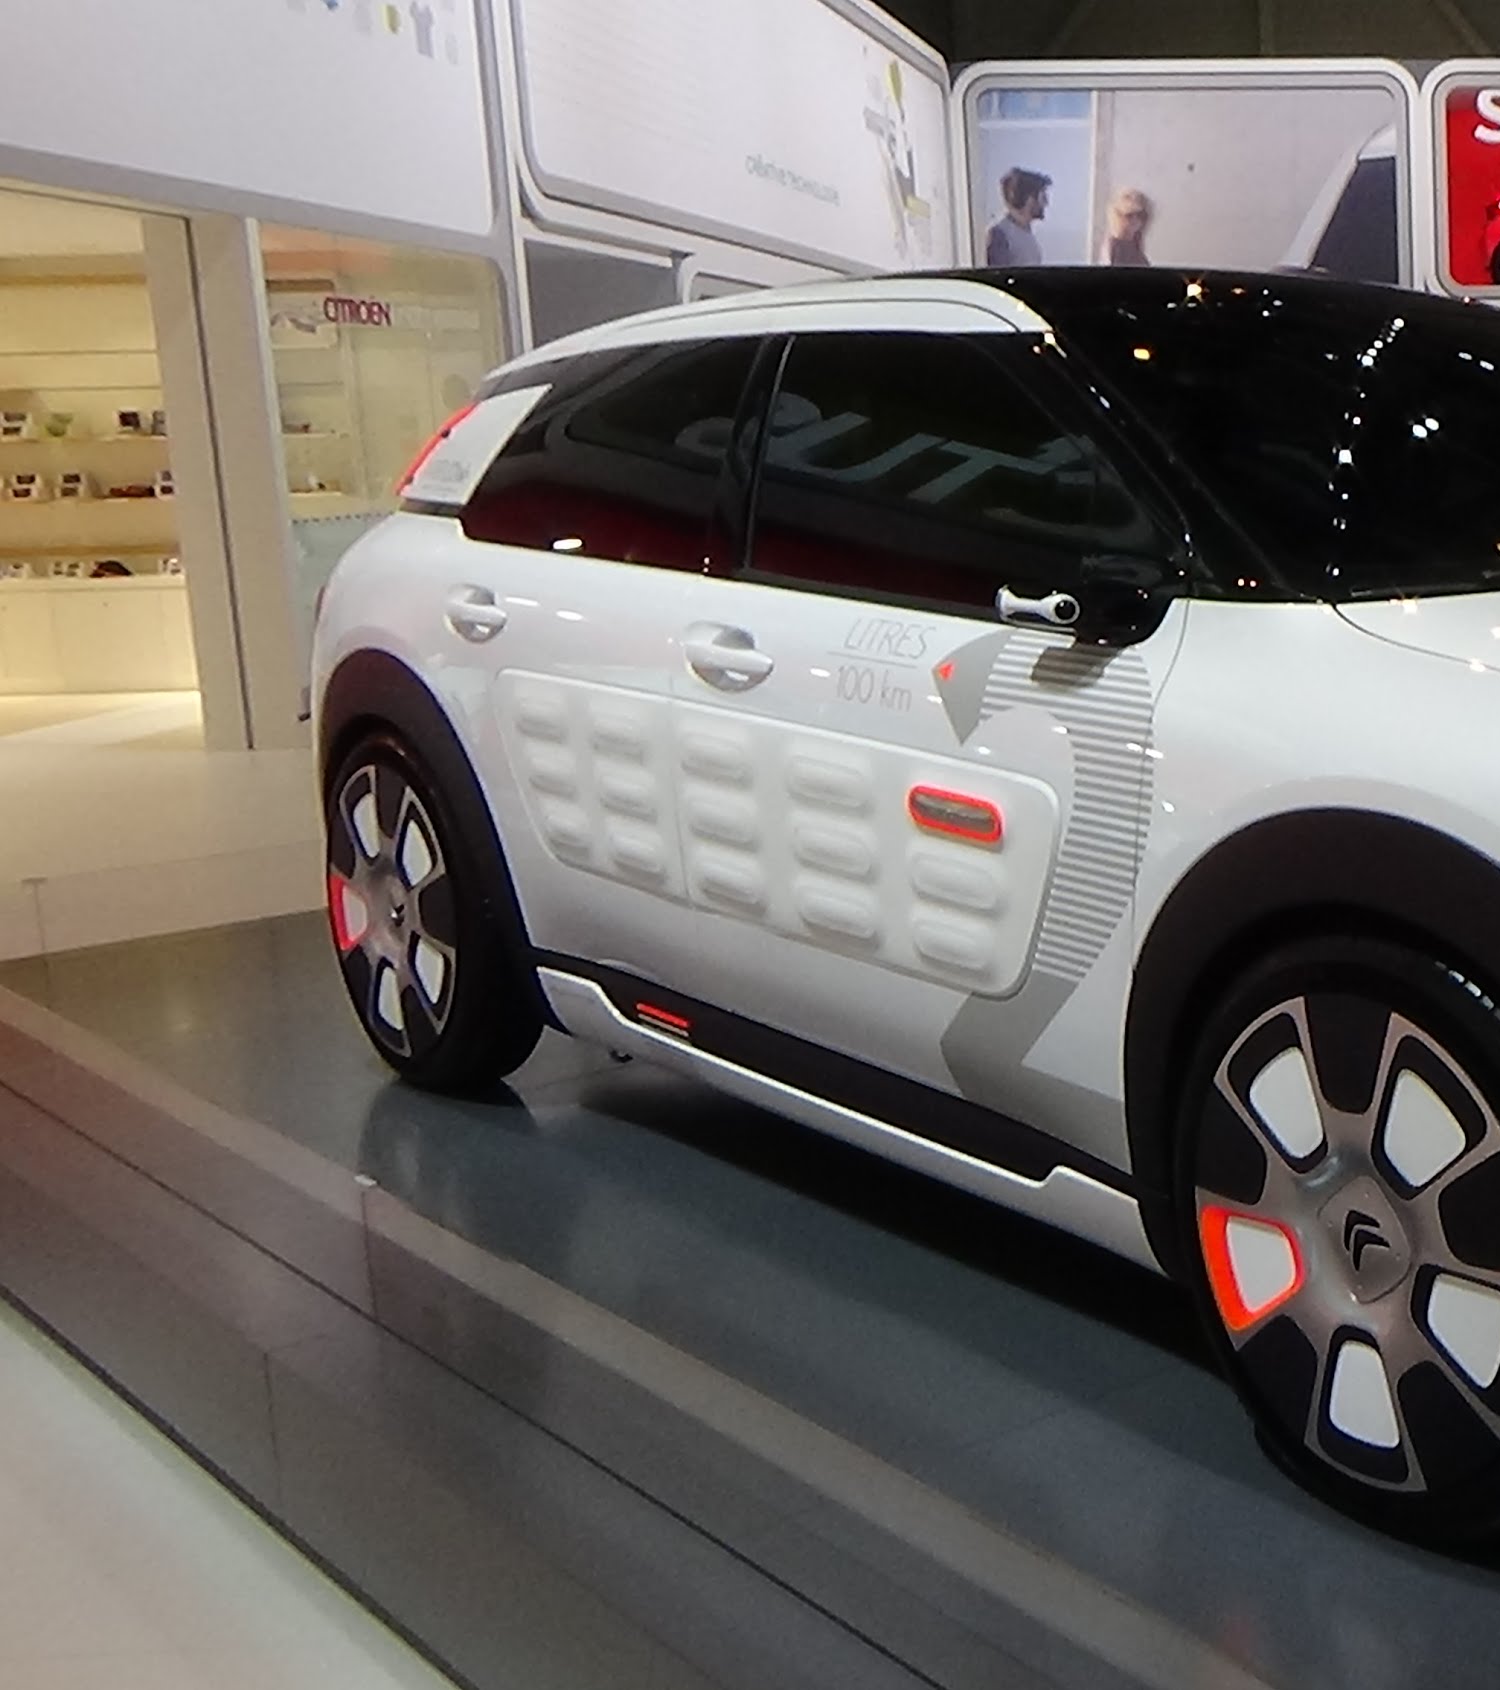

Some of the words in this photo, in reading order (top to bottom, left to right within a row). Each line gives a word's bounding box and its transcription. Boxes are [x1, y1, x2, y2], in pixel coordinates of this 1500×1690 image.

[843, 616, 938, 660] LITRES
[836, 664, 875, 704] 100
[879, 669, 913, 713] km
